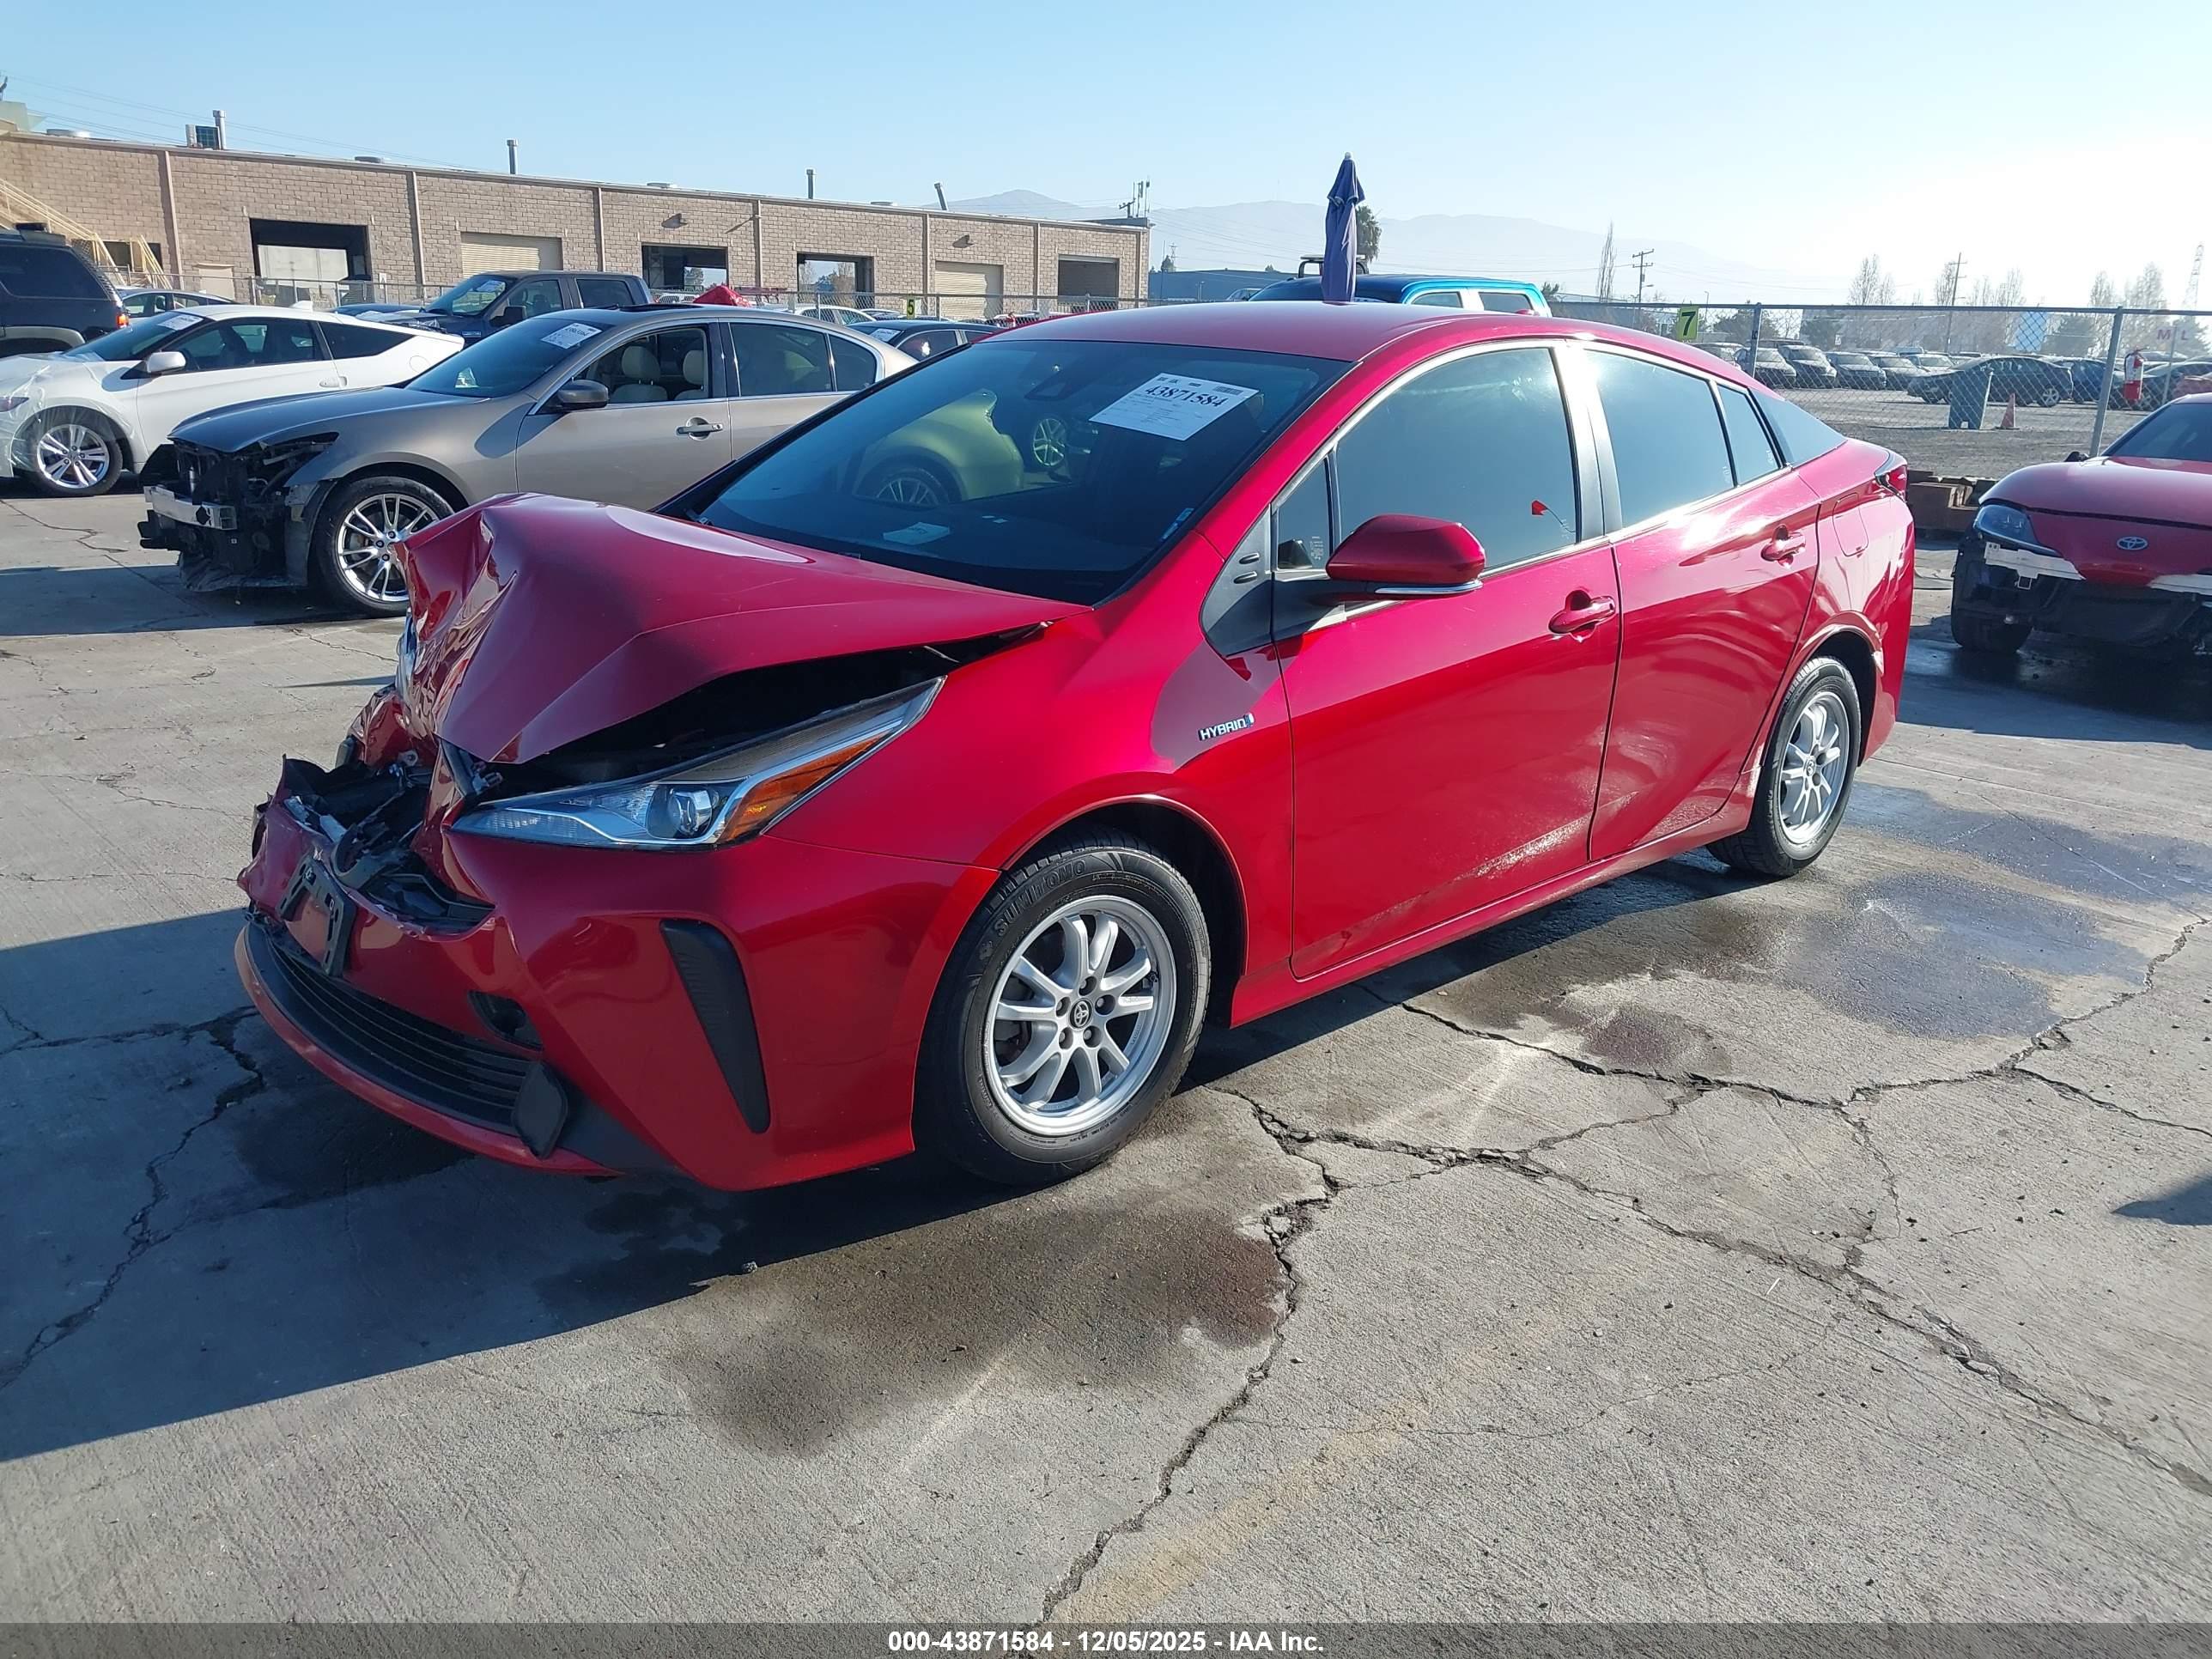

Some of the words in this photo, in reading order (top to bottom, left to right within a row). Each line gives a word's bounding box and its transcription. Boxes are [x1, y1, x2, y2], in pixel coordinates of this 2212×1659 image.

[908, 299, 915, 316] 5
[1681, 311, 1697, 337] 7
[2156, 329, 2172, 340] M
[2181, 329, 2189, 341] L
[1145, 385, 1229, 407] 43871584
[1200, 718, 1247, 740] HYBRID
[994, 859, 1086, 938] SUMITOMO
